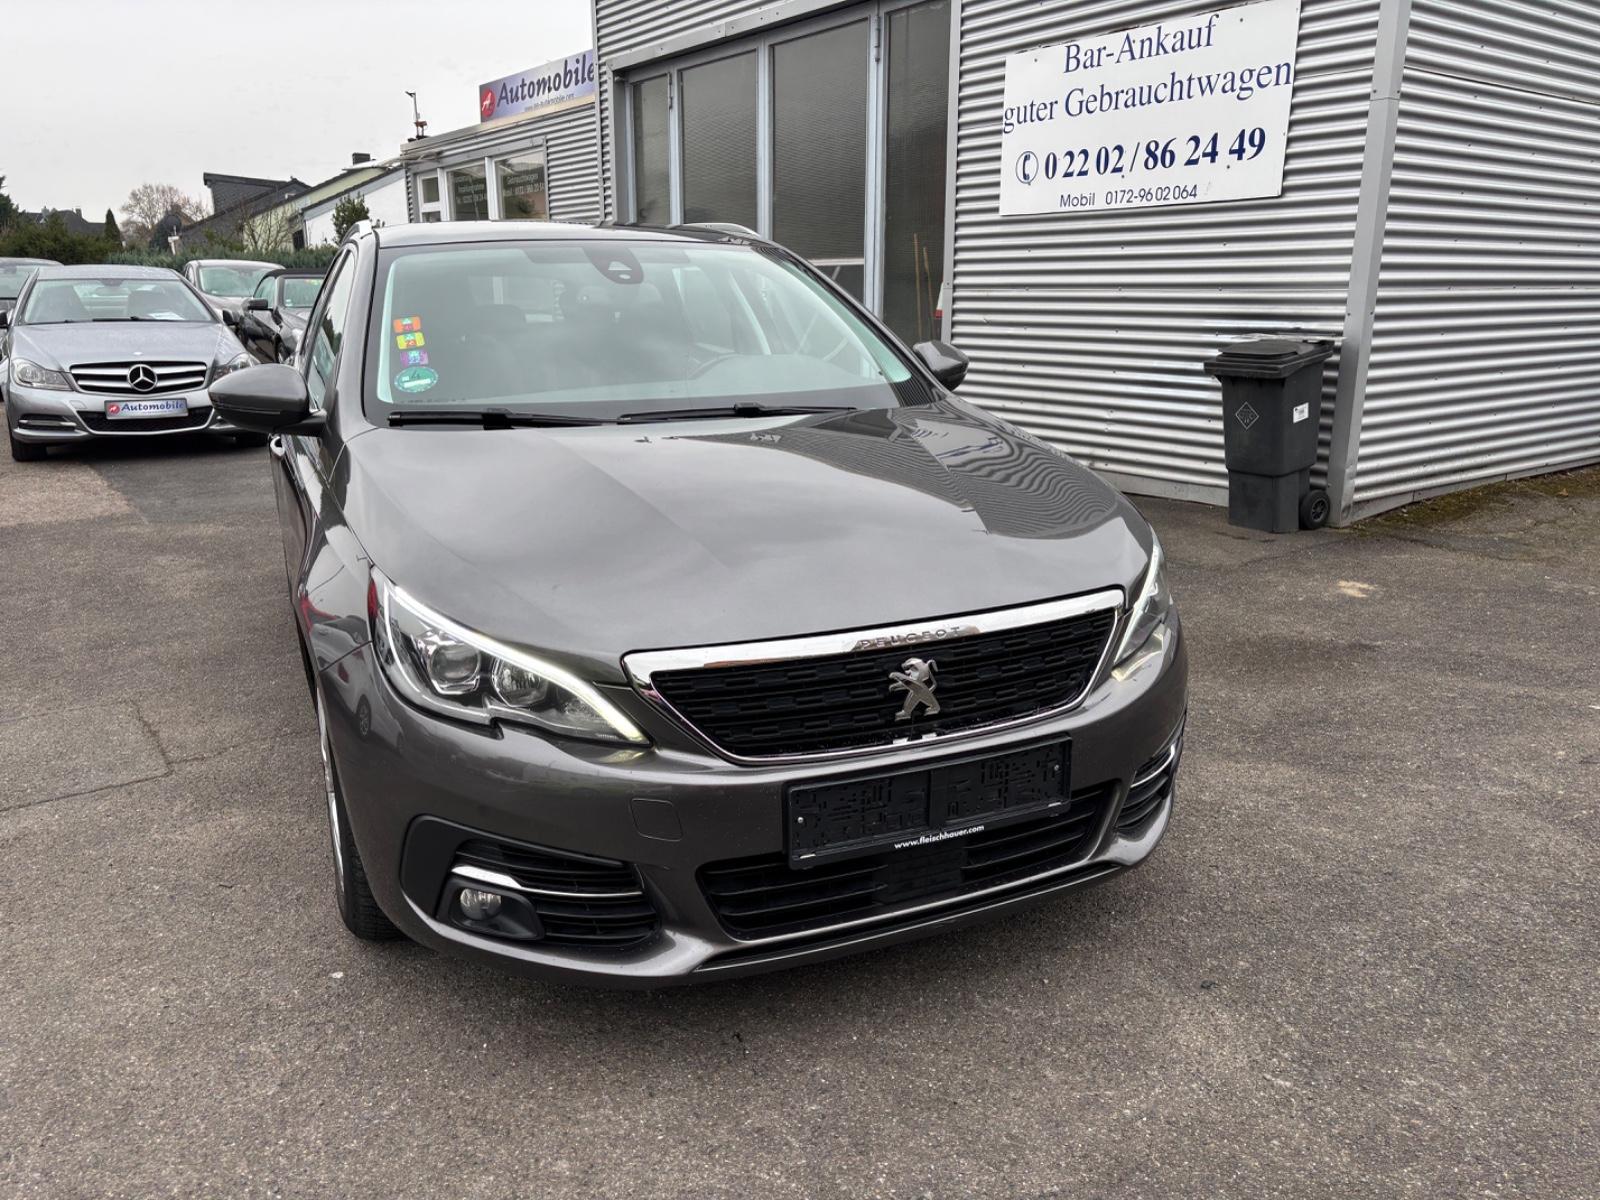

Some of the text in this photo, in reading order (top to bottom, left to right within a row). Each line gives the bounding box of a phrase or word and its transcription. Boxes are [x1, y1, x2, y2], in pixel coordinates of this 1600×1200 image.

[1063, 14, 1220, 74] Bar-Ankauf
[497, 54, 595, 107] Automobile
[1003, 61, 1292, 134] guter Gebrauchtwagen
[1059, 192, 1095, 208] Mobil
[121, 401, 184, 412] Automobile
[861, 626, 960, 648] PEUGEOT
[894, 825, 985, 849] www.fleischhauer.com
